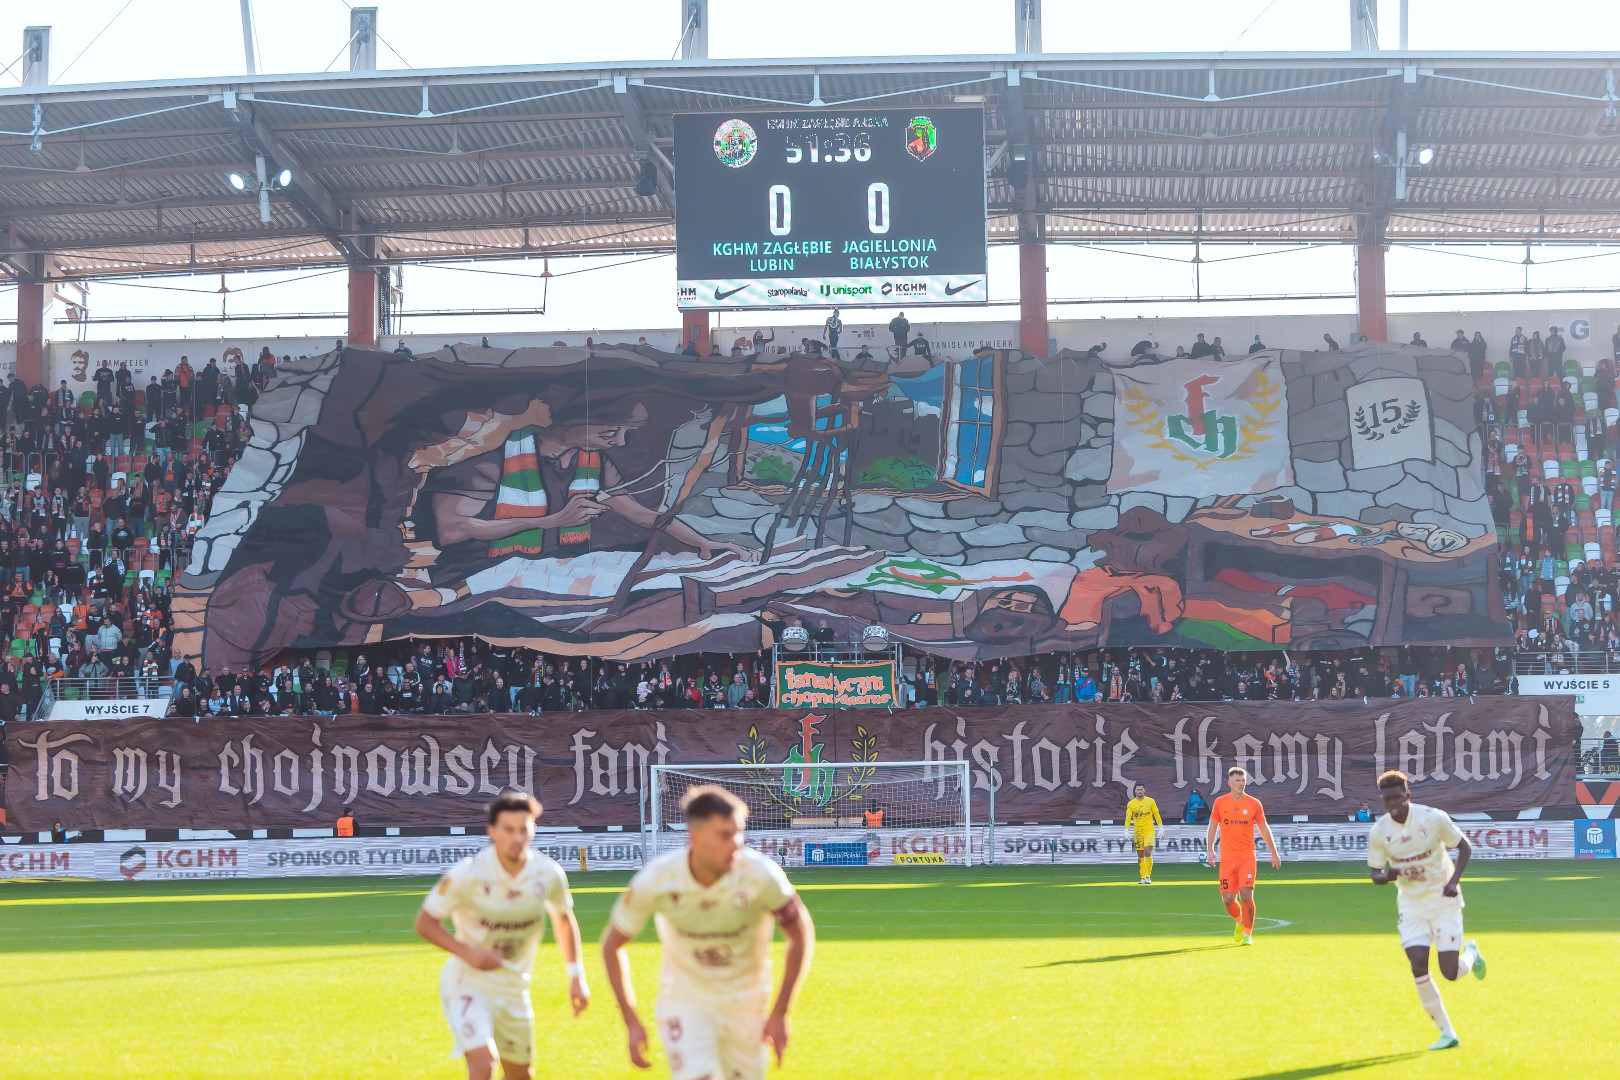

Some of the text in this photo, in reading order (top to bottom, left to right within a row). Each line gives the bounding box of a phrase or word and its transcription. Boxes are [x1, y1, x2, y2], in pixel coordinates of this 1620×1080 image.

[769, 185, 791, 236] 0
[867, 182, 890, 233] 0
[713, 240, 832, 257] KGHM ZAGŁĘBIE
[842, 238, 937, 253] JAGIELLONIA
[750, 258, 794, 271] LUBIN
[850, 255, 929, 270] BIAŁYSTOK
[832, 284, 872, 296] unisport
[896, 283, 927, 292] KGHM
[931, 340, 975, 349] TANISŁAW
[1368, 398, 1402, 430] 15
[1544, 679, 1610, 690] WYJŚCIE 5
[85, 704, 150, 714] WYJŚCIE 7
[112, 746, 183, 809] my
[217, 722, 538, 812] chojnowscy
[567, 721, 671, 805] fani
[1163, 716, 1345, 801] tkamy
[1373, 703, 1552, 790] latami
[891, 835, 974, 855] KGHM
[1004, 838, 1098, 854] SPONSOR
[1330, 835, 1368, 850] LUB
[1466, 829, 1549, 848] KGHM
[157, 849, 238, 869] KGHM
[267, 850, 361, 867] SPONSOR
[587, 844, 643, 861] LUBIN
[900, 856, 945, 864] FORTUNA
[460, 995, 473, 1017] 7
